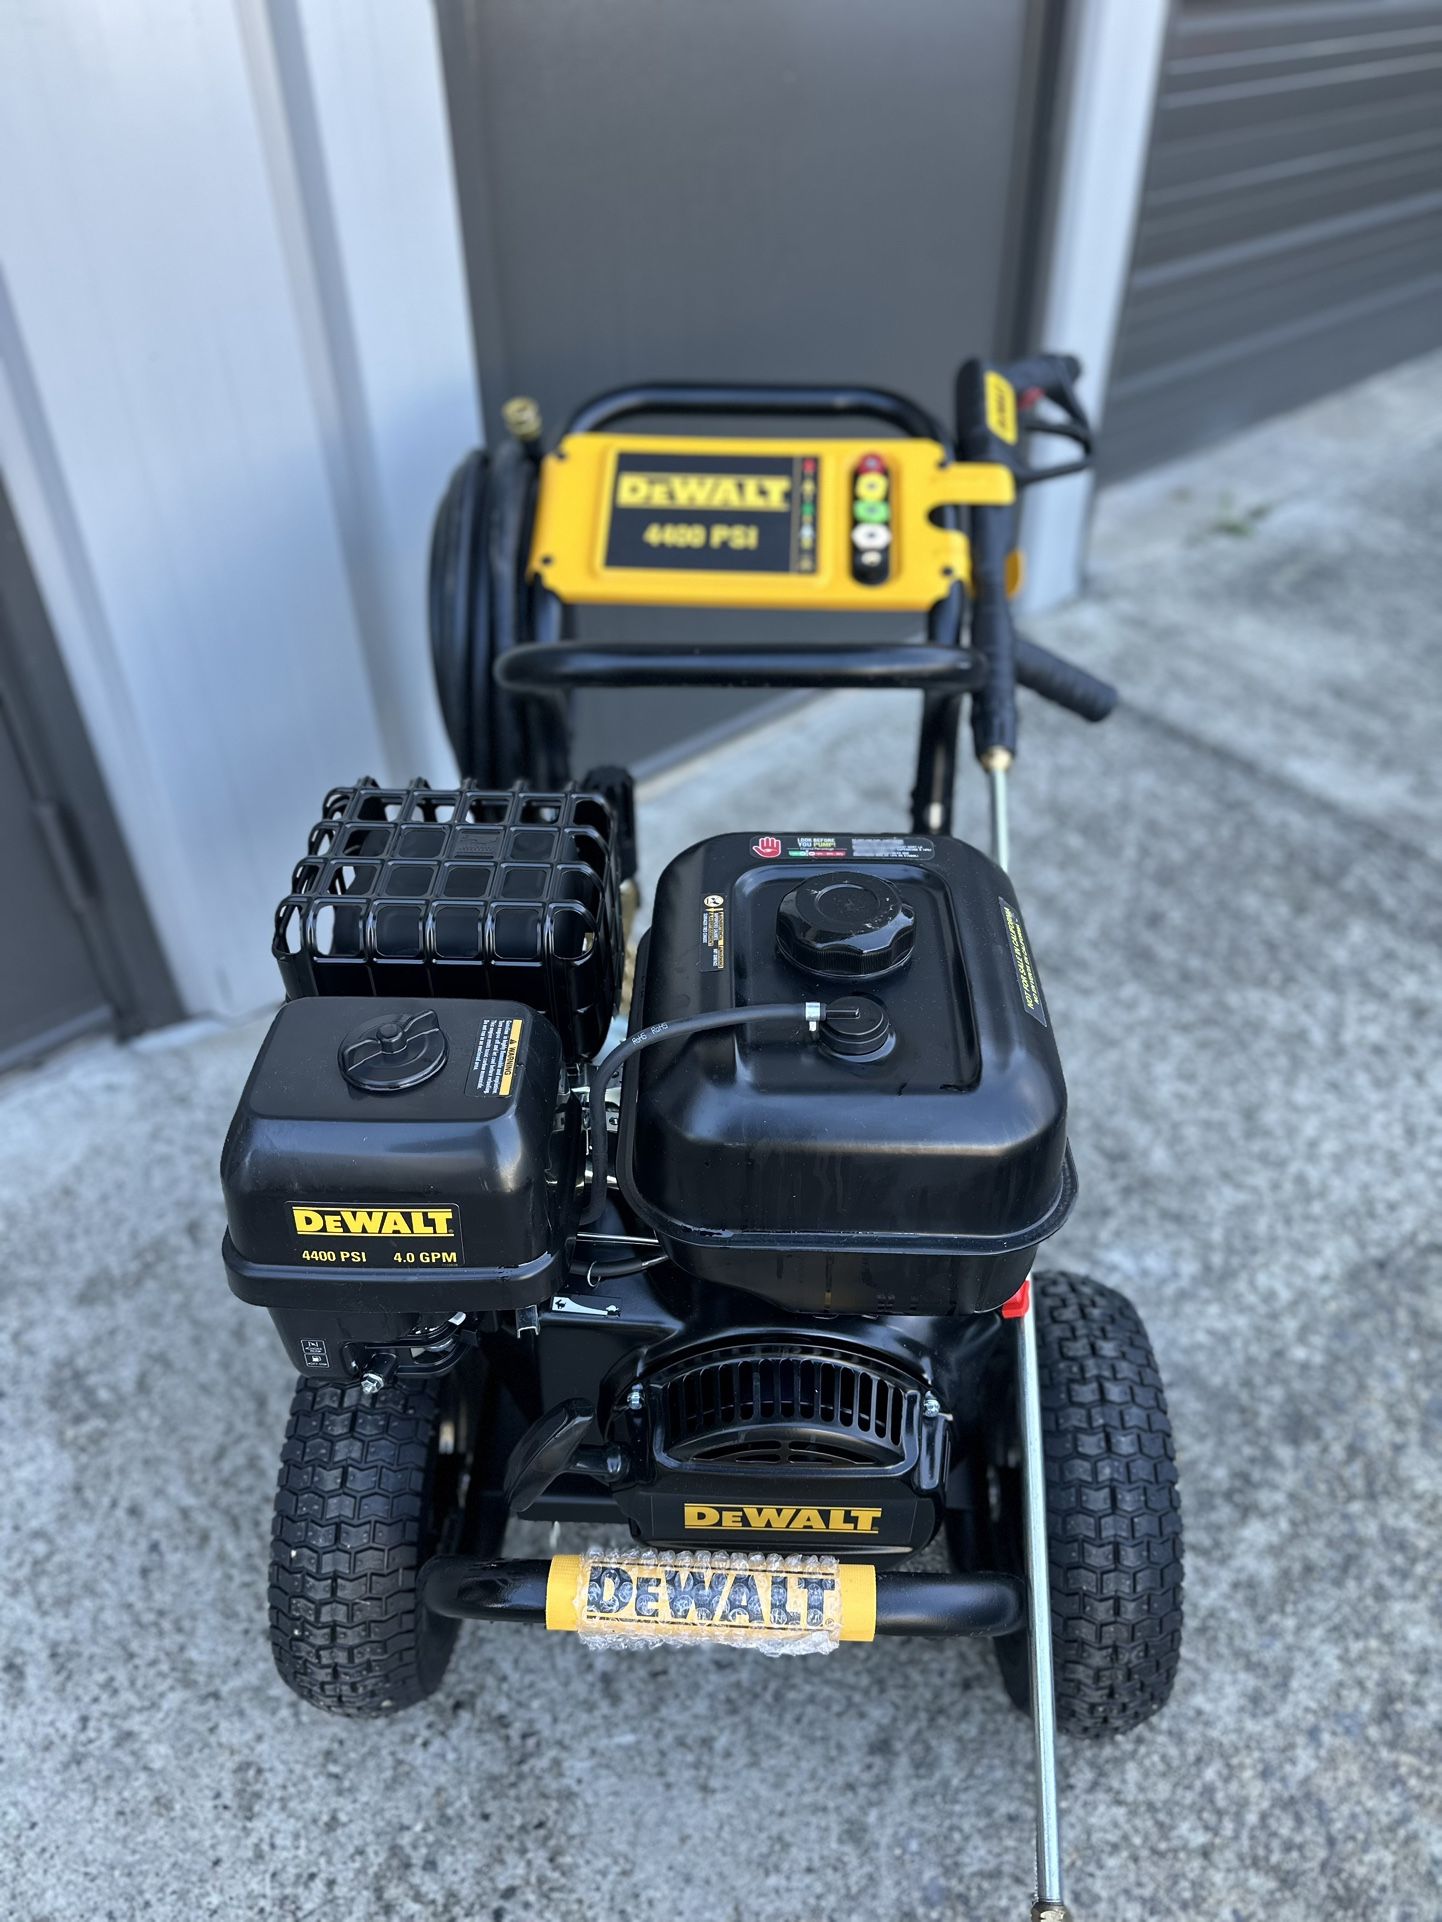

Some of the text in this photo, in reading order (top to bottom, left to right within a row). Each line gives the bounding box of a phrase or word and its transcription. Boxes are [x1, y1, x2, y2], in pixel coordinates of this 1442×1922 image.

[643, 523, 758, 549] 4400 PSI
[1003, 906, 1019, 947] CALIFORNIA
[1015, 955, 1026, 975] SALE
[1020, 975, 1030, 992] FOR
[1024, 990, 1034, 1010] NOT
[504, 1047, 516, 1076] WARNING
[293, 1209, 453, 1234] DEWALT
[302, 1250, 457, 1263] 4400 PSI 4.0 GPM
[684, 1506, 882, 1531] DEWALT
